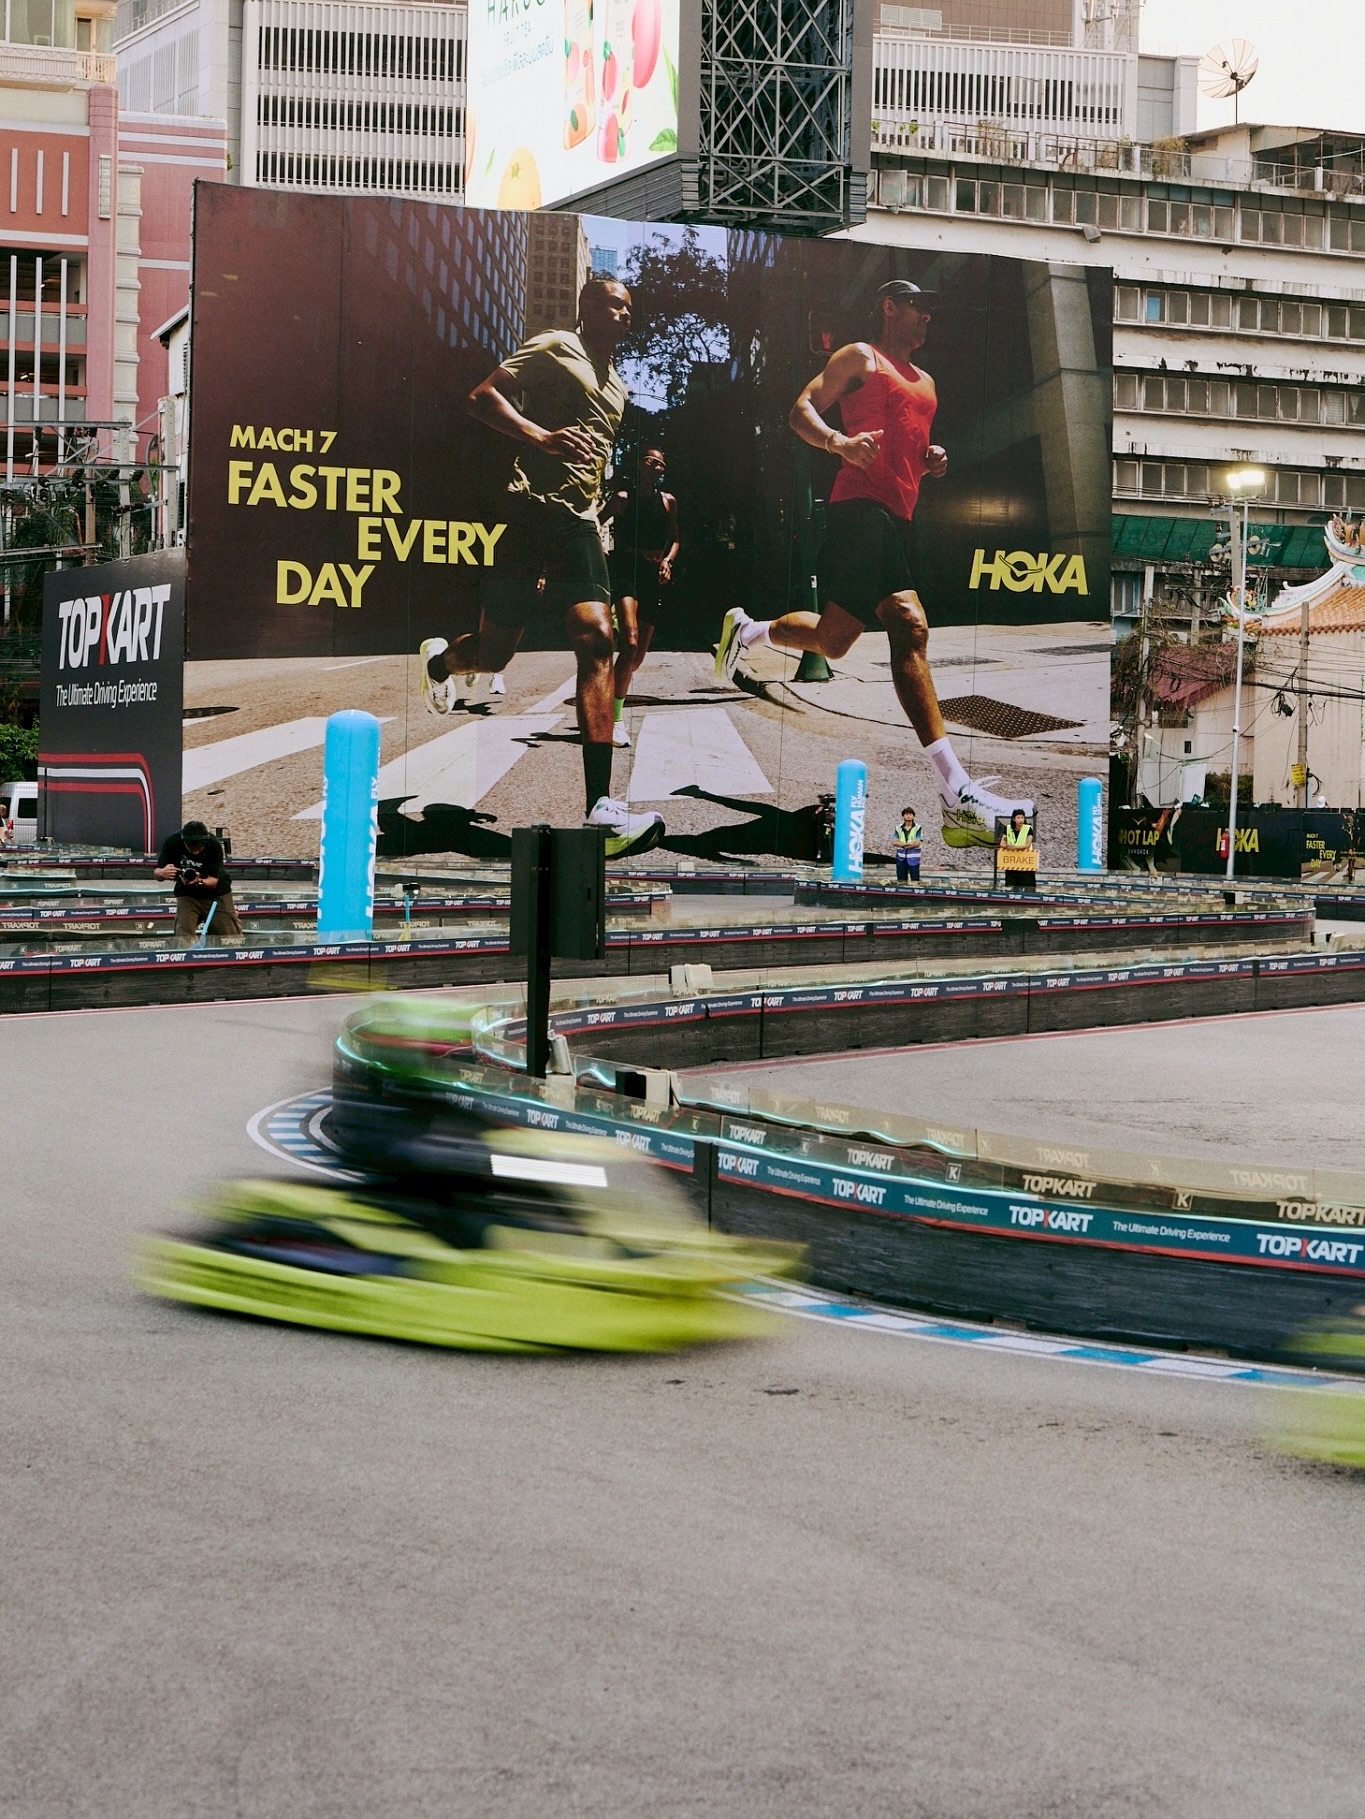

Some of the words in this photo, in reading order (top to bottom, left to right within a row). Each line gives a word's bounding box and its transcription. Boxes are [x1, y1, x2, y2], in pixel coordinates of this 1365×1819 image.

[229, 424, 314, 453] MACH
[318, 431, 338, 454] 7
[227, 460, 404, 514] FASTER
[357, 516, 508, 566] EVERY
[276, 559, 376, 608] DAY
[968, 548, 1089, 595] HOKA
[58, 584, 171, 670] TOPKART
[56, 685, 67, 707] The
[68, 682, 93, 706] Ultimate
[94, 681, 117, 708] Driving
[118, 678, 158, 707] Experience
[848, 810, 864, 874] HOKA
[1119, 829, 1141, 846] HOT
[1142, 830, 1160, 846] LAP
[1003, 855, 1035, 865] BRAKE
[526, 1109, 559, 1129] TOPKART
[729, 1124, 767, 1145] TOPKART
[718, 1152, 760, 1176] TOPKART
[847, 1148, 895, 1171] TOPKART
[832, 1178, 886, 1205] TOPKART
[1022, 1174, 1097, 1198] TOPKART
[1009, 1204, 1093, 1232] TOPKART
[1276, 1200, 1365, 1226] TOPKART
[1113, 1221, 1128, 1232] The
[1128, 1222, 1159, 1236] Ultimate
[1160, 1226, 1187, 1240] Driving
[1187, 1229, 1231, 1243] Experience
[1256, 1233, 1364, 1264] TOPKART
